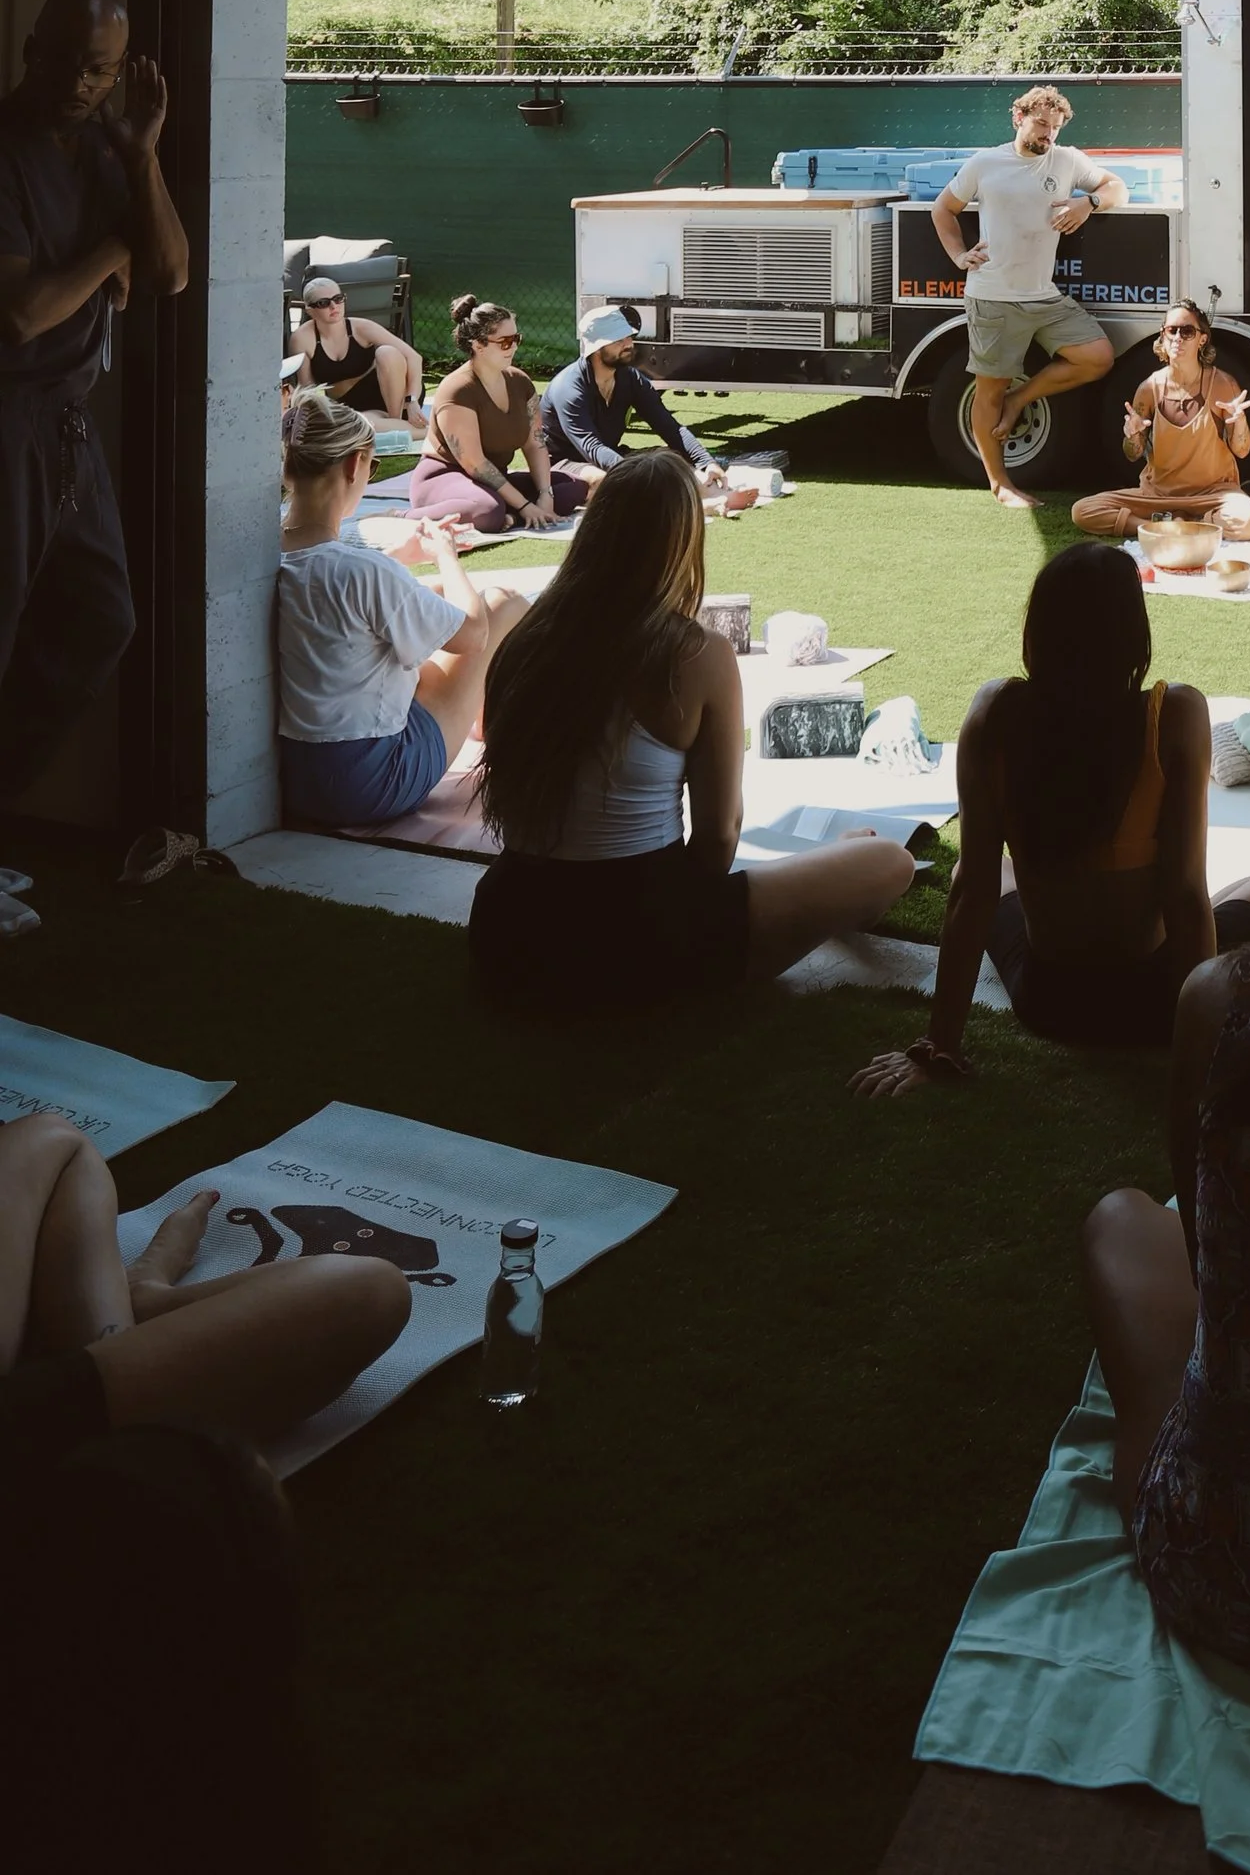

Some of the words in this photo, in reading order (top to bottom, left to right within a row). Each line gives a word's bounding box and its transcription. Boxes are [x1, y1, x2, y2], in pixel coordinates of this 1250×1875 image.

[1055, 259, 1082, 276] HE
[900, 280, 966, 298] ELEME
[1056, 283, 1169, 304] FERENCE
[266, 1159, 343, 1191] YOGA
